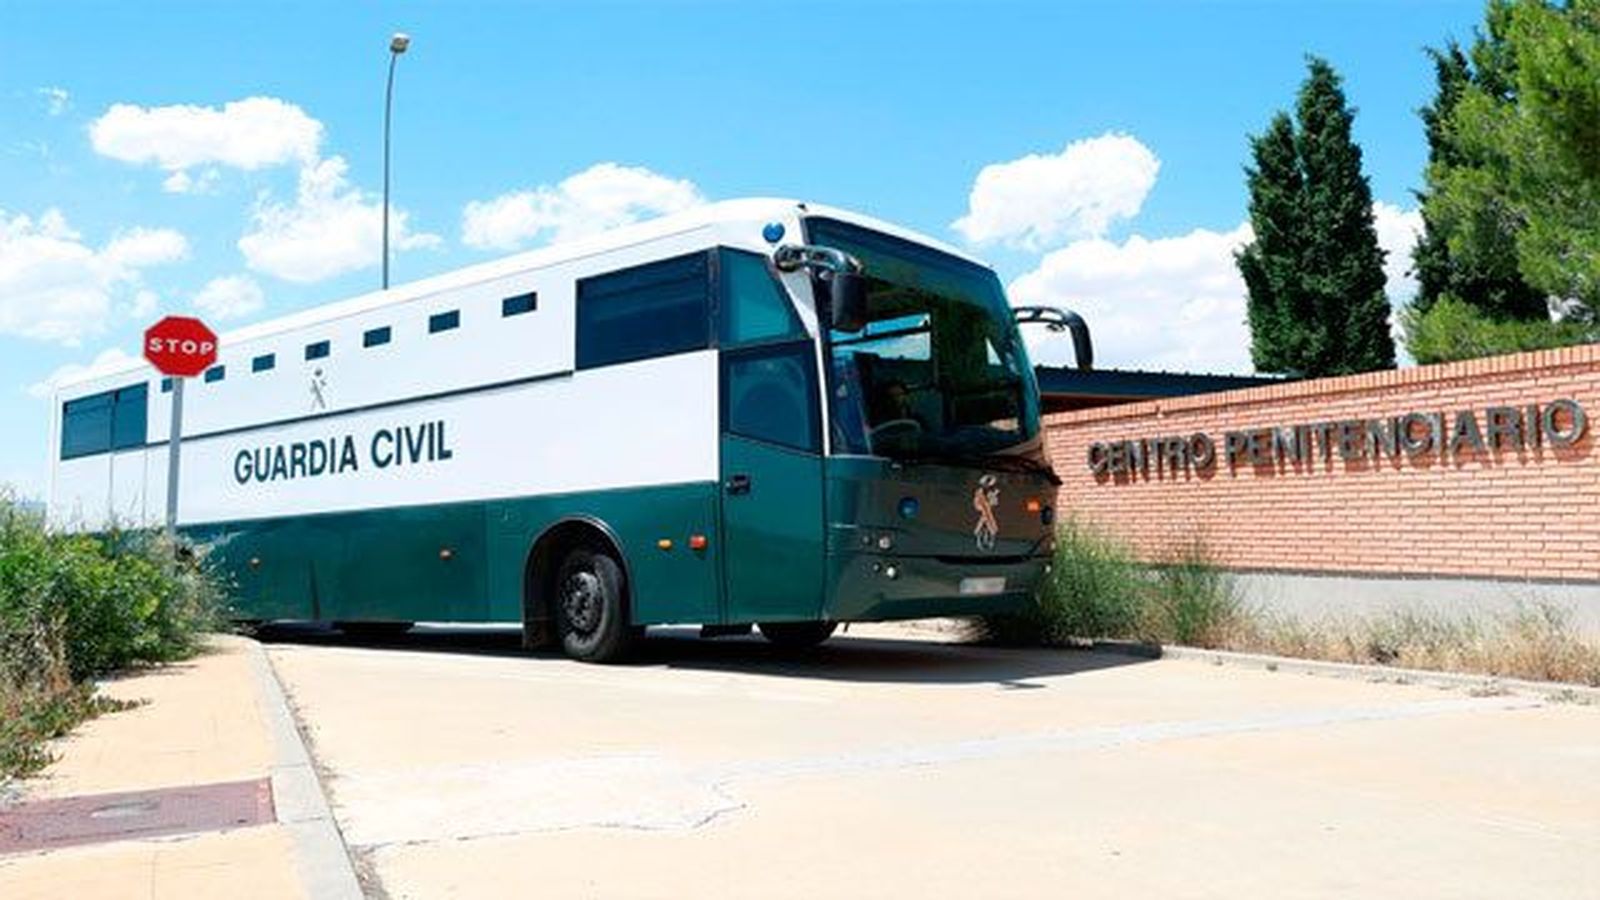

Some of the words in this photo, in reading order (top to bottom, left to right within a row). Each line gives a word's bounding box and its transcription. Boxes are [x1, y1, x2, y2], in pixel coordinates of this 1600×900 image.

[149, 337, 215, 355] STOP
[234, 434, 359, 485] GUARDIA
[371, 420, 453, 469] CIVIL
[1088, 432, 1215, 476] CENTRO
[1225, 399, 1586, 464] PENITENCIARIO
